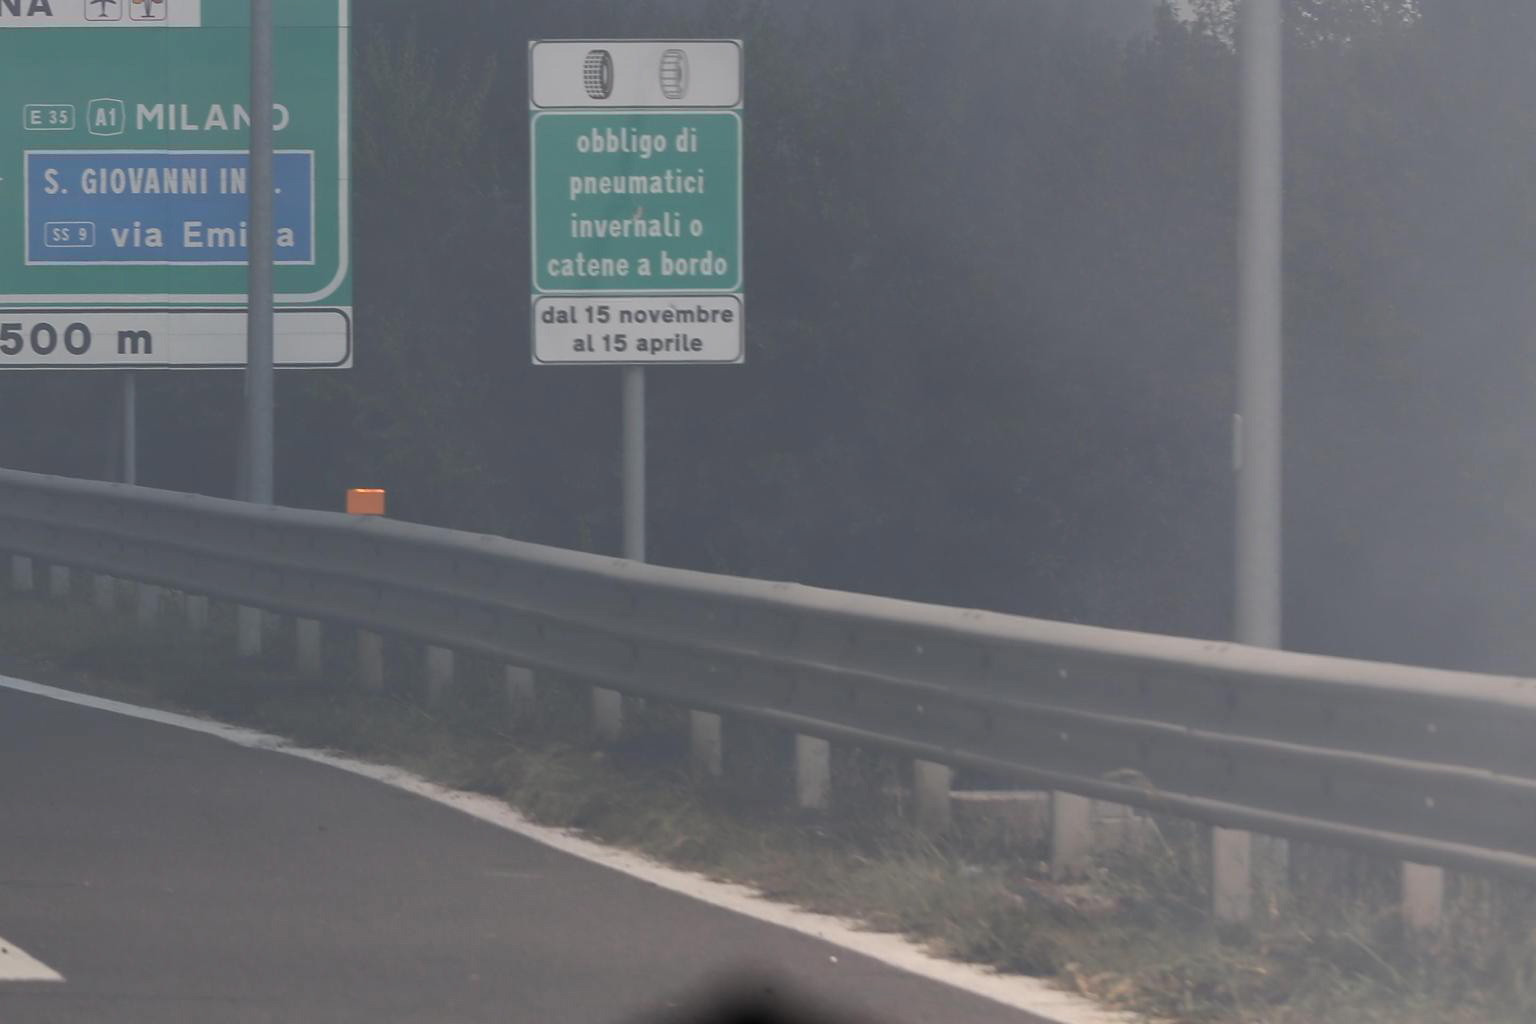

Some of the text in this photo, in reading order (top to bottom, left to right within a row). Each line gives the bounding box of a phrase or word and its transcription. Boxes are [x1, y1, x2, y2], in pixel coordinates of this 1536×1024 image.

[30, 110, 41, 124] E
[48, 110, 69, 124] 35
[95, 108, 117, 127] A1
[577, 128, 698, 159] obbligo di
[44, 168, 68, 194] S.
[81, 168, 207, 194] GIOVANNI
[220, 168, 246, 194] IN
[570, 169, 705, 200] pneumatici
[53, 221, 295, 248] SS 9 via Emia
[571, 212, 703, 238] invernali o
[548, 250, 728, 276] catene a bordo
[541, 305, 734, 324] dal 15 novembre
[0, 323, 153, 356] 500 m
[573, 334, 703, 355] al 15 aprile
